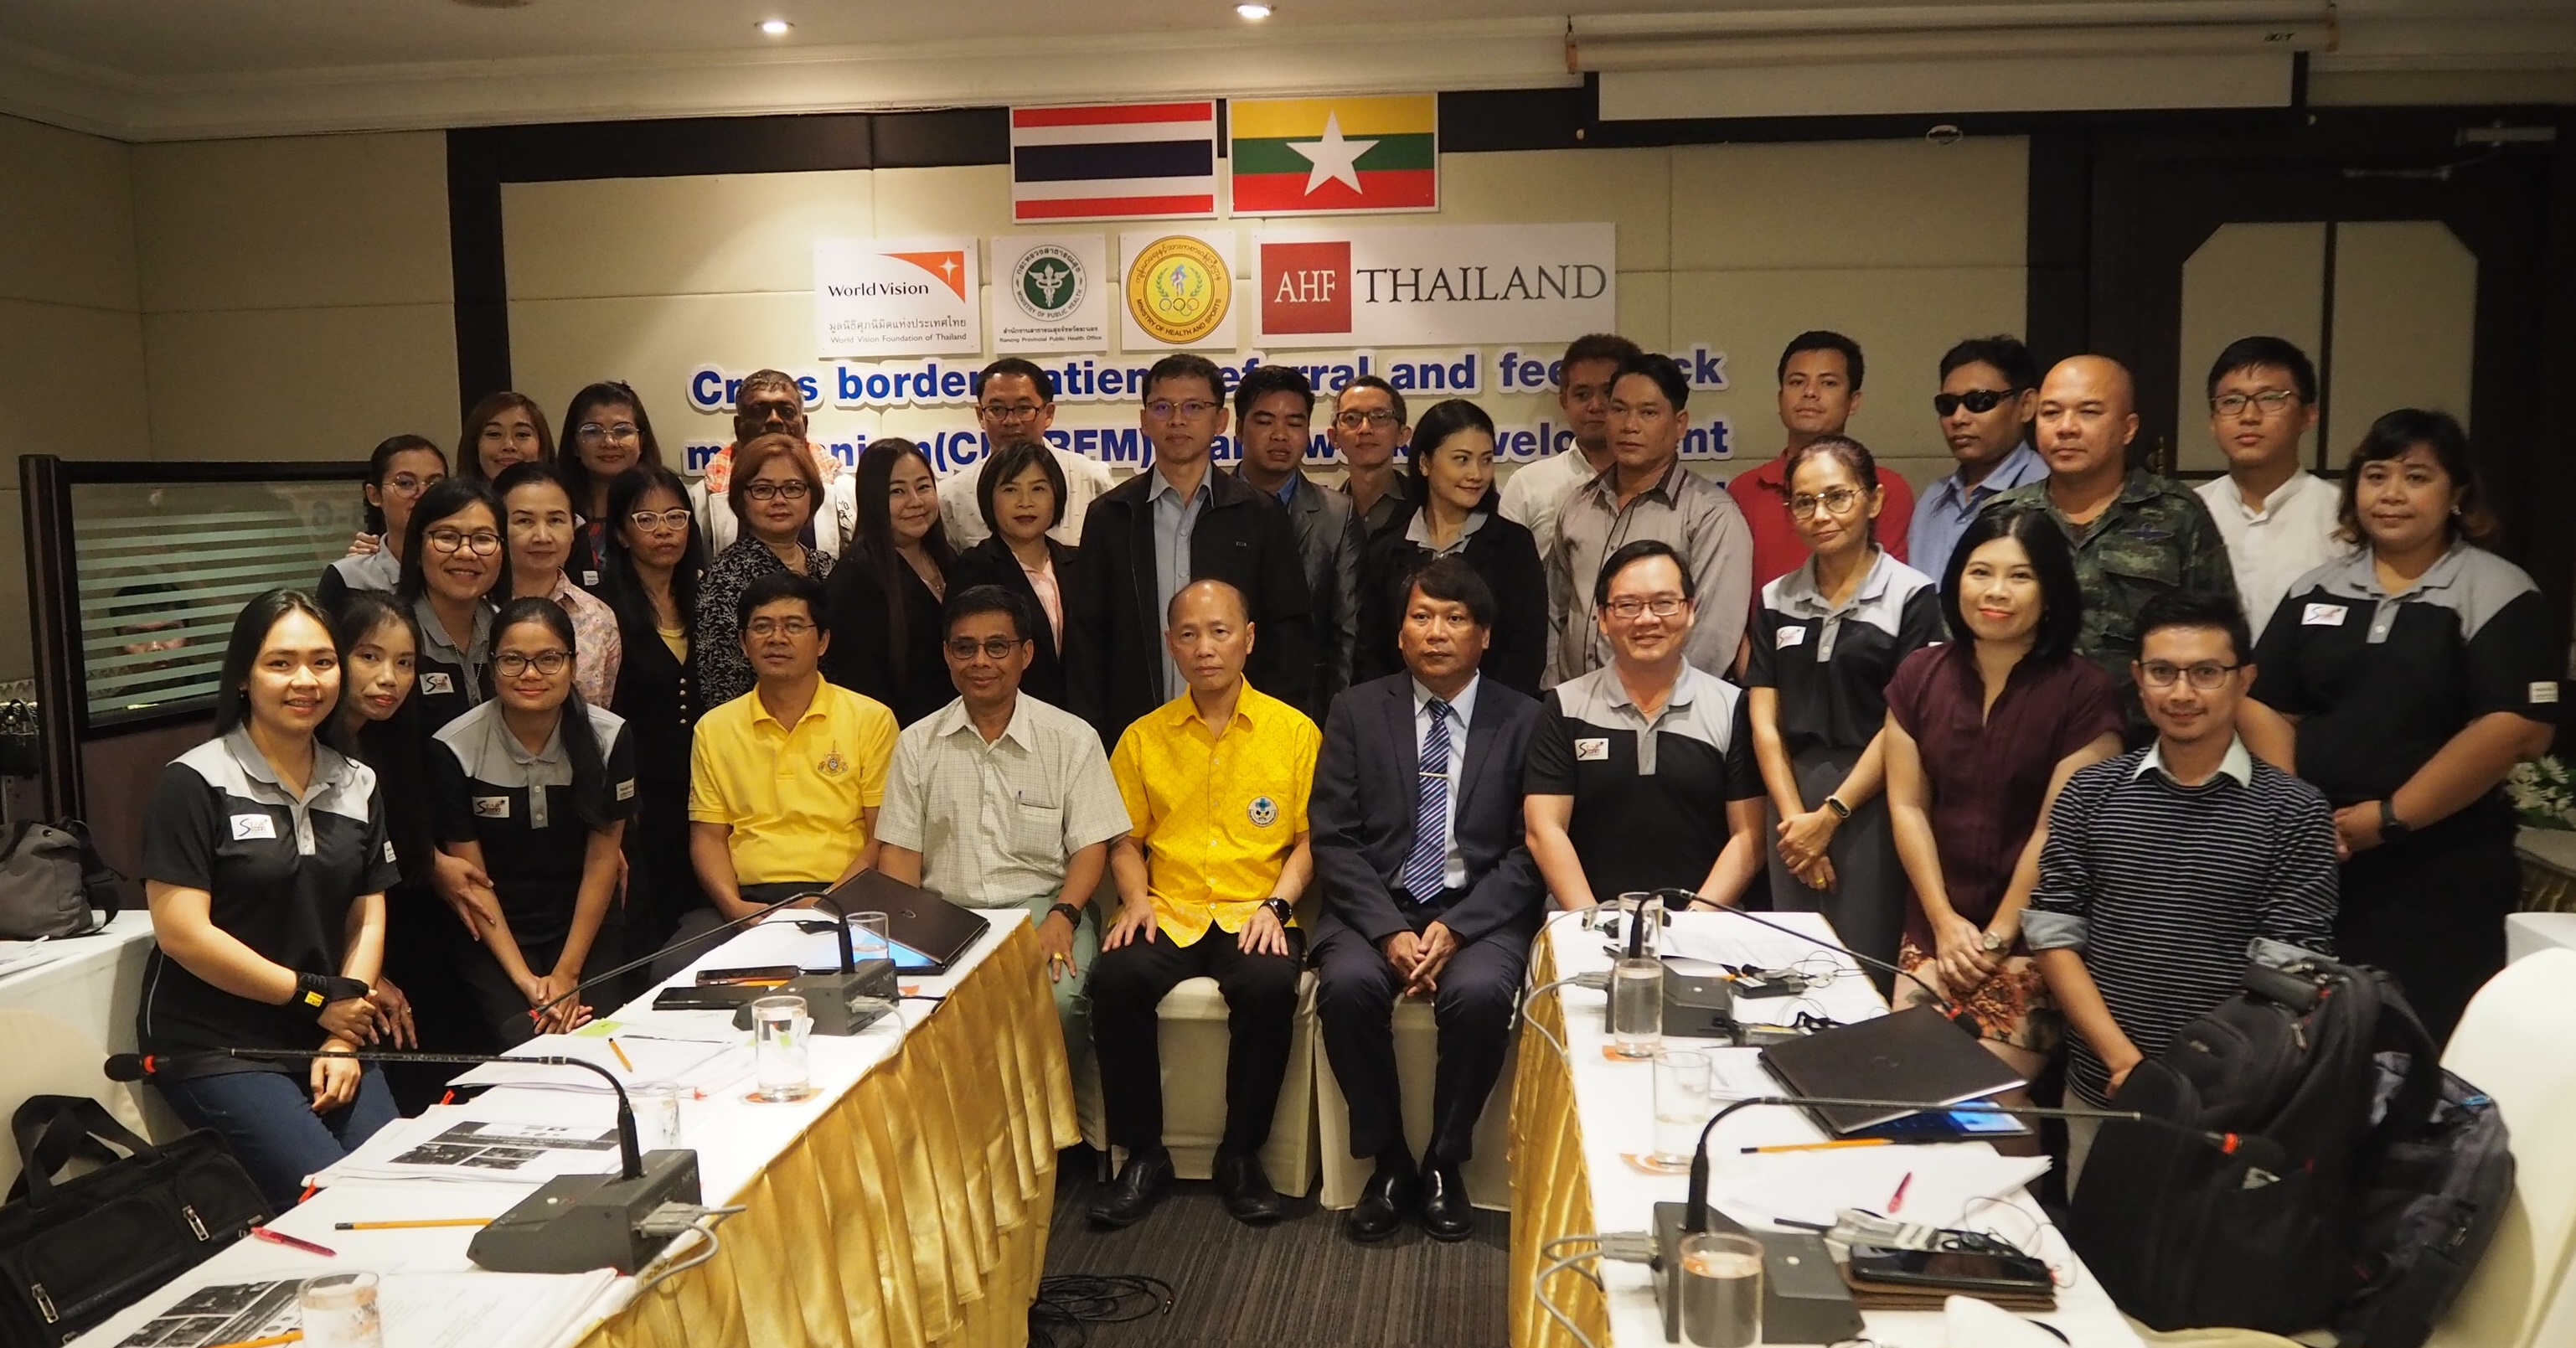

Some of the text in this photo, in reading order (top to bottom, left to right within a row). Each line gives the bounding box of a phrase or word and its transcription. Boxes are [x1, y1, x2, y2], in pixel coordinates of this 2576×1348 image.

[828, 281, 929, 297] World Vision
[1274, 264, 1607, 303] AHF THAILAND
[1017, 290, 1035, 314] MINISTRY
[1047, 309, 1068, 318] PUBLIC
[1068, 288, 1082, 311] HEALTH
[1137, 298, 1221, 337] MINISTRY OF HEALTH AND SPORTS
[829, 315, 967, 334] มูลนิธิศุภนิมิตแห่งประเทศไทย
[882, 334, 923, 343] Foundation
[925, 333, 933, 342] of
[936, 333, 967, 341] Thailand
[693, 370, 819, 405] Crs
[1391, 354, 1475, 390] and
